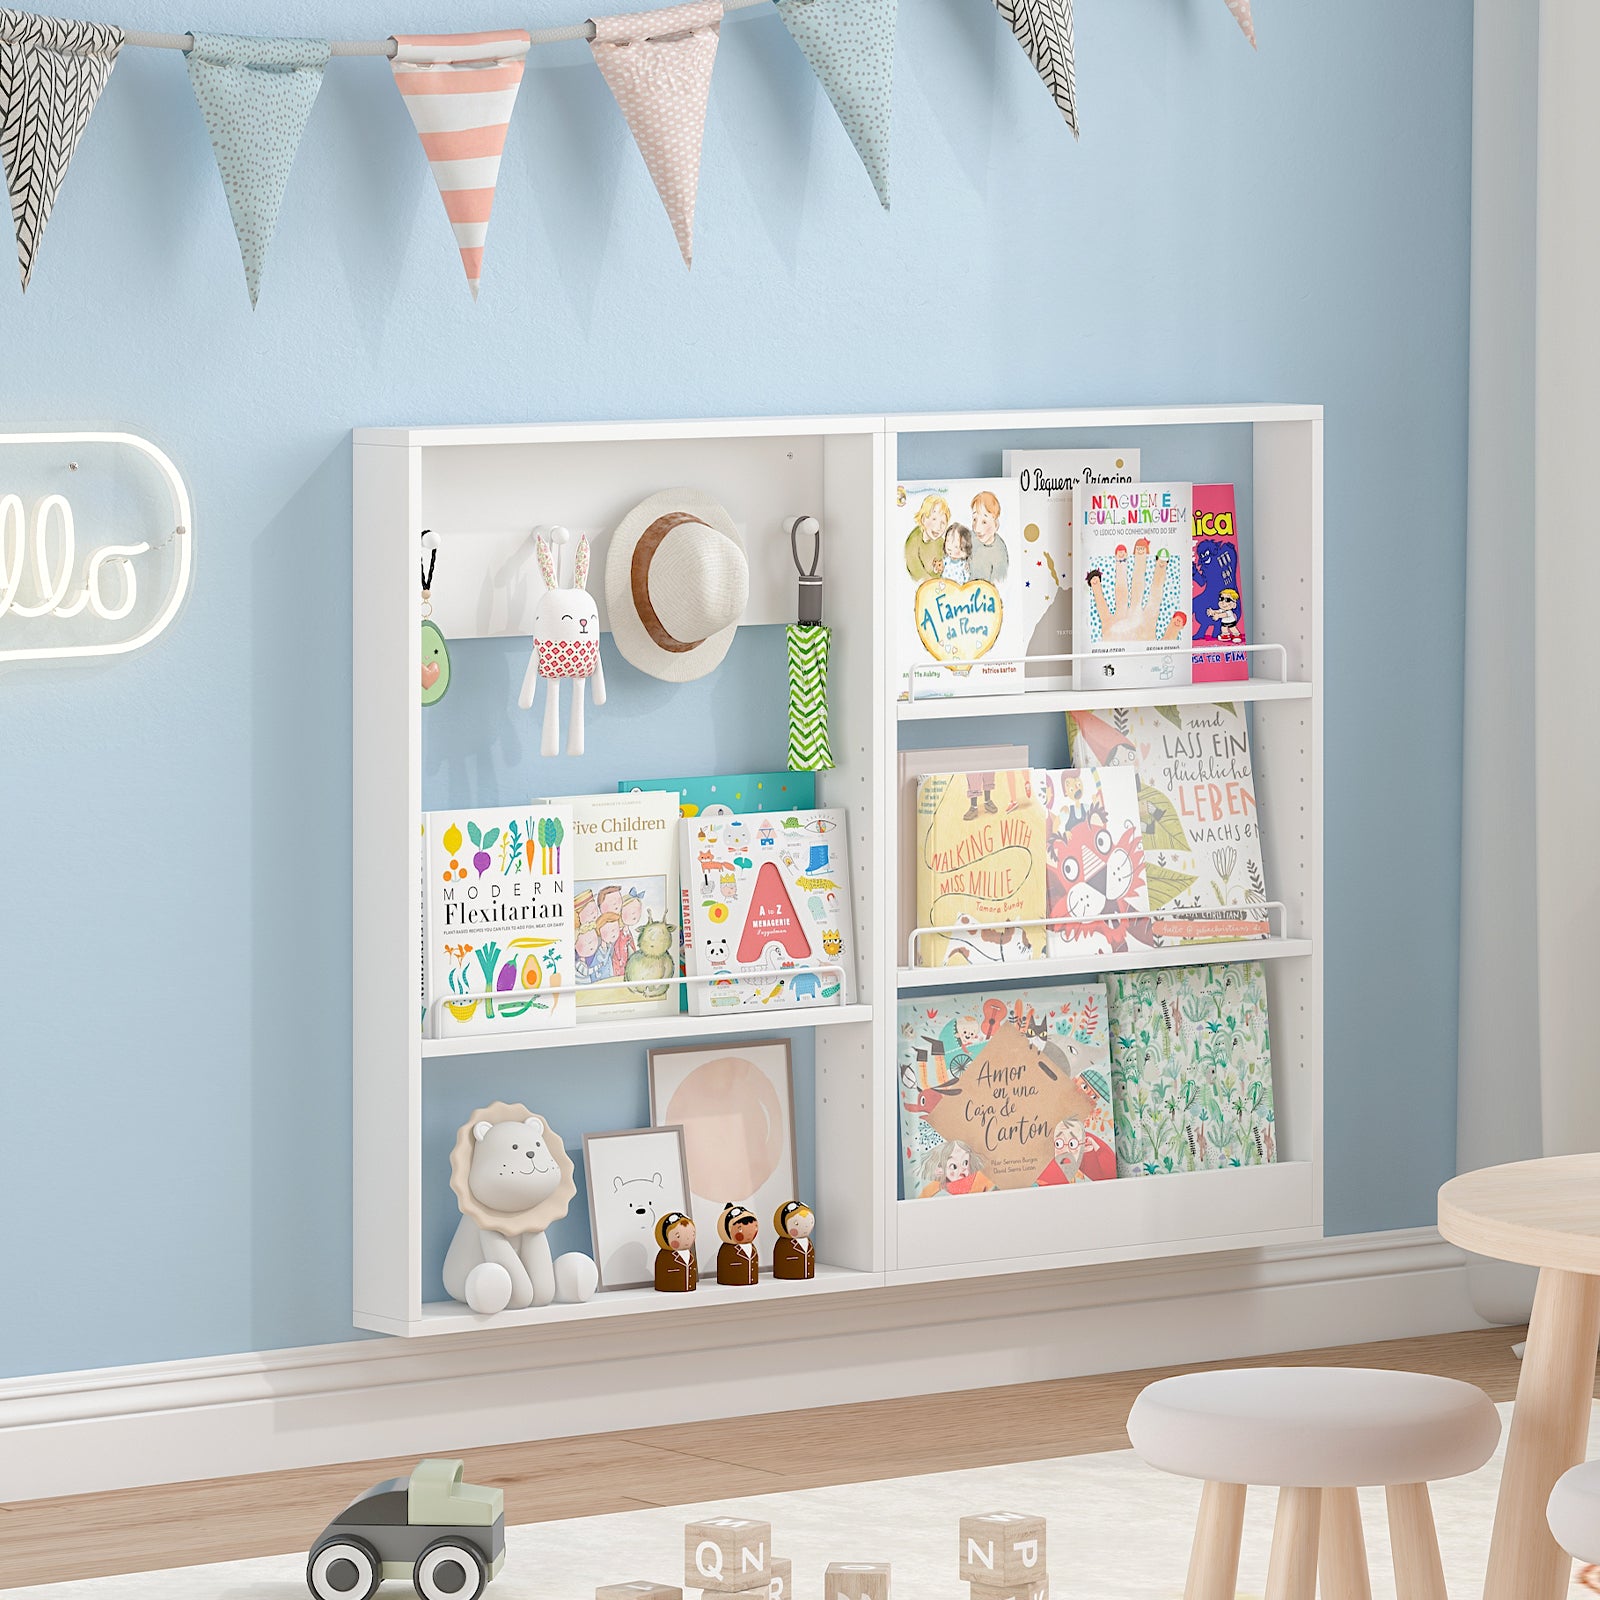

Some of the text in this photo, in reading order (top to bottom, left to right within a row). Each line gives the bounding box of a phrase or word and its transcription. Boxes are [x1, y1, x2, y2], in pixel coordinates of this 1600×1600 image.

[1020, 468, 1030, 492] O
[1161, 490, 1172, 508] É
[1084, 509, 1121, 526] IGUAL
[920, 587, 996, 643] A Família
[946, 616, 989, 641] da Flora
[1187, 711, 1225, 729] und
[1162, 732, 1203, 759] LASS
[573, 815, 666, 835] ive Children
[1000, 818, 1032, 849] WITH
[594, 836, 639, 853] and It
[940, 868, 1013, 899] MISS MILLIE
[444, 897, 565, 926] Flexitarian
[681, 889, 693, 949] MENAGERIE
[759, 905, 766, 916] A
[776, 904, 783, 915] Z
[976, 898, 1024, 913] Tamara Bundy
[752, 917, 791, 928] MENAGERIE
[977, 1060, 1027, 1088] Amor
[993, 1086, 1039, 1099] en una
[965, 1097, 1017, 1128] Caja de
[985, 1115, 1054, 1152] Cartón
[695, 1540, 724, 1582] Q
[741, 1542, 764, 1574] N
[967, 1537, 994, 1570] N
[1013, 1539, 1038, 1568] P
